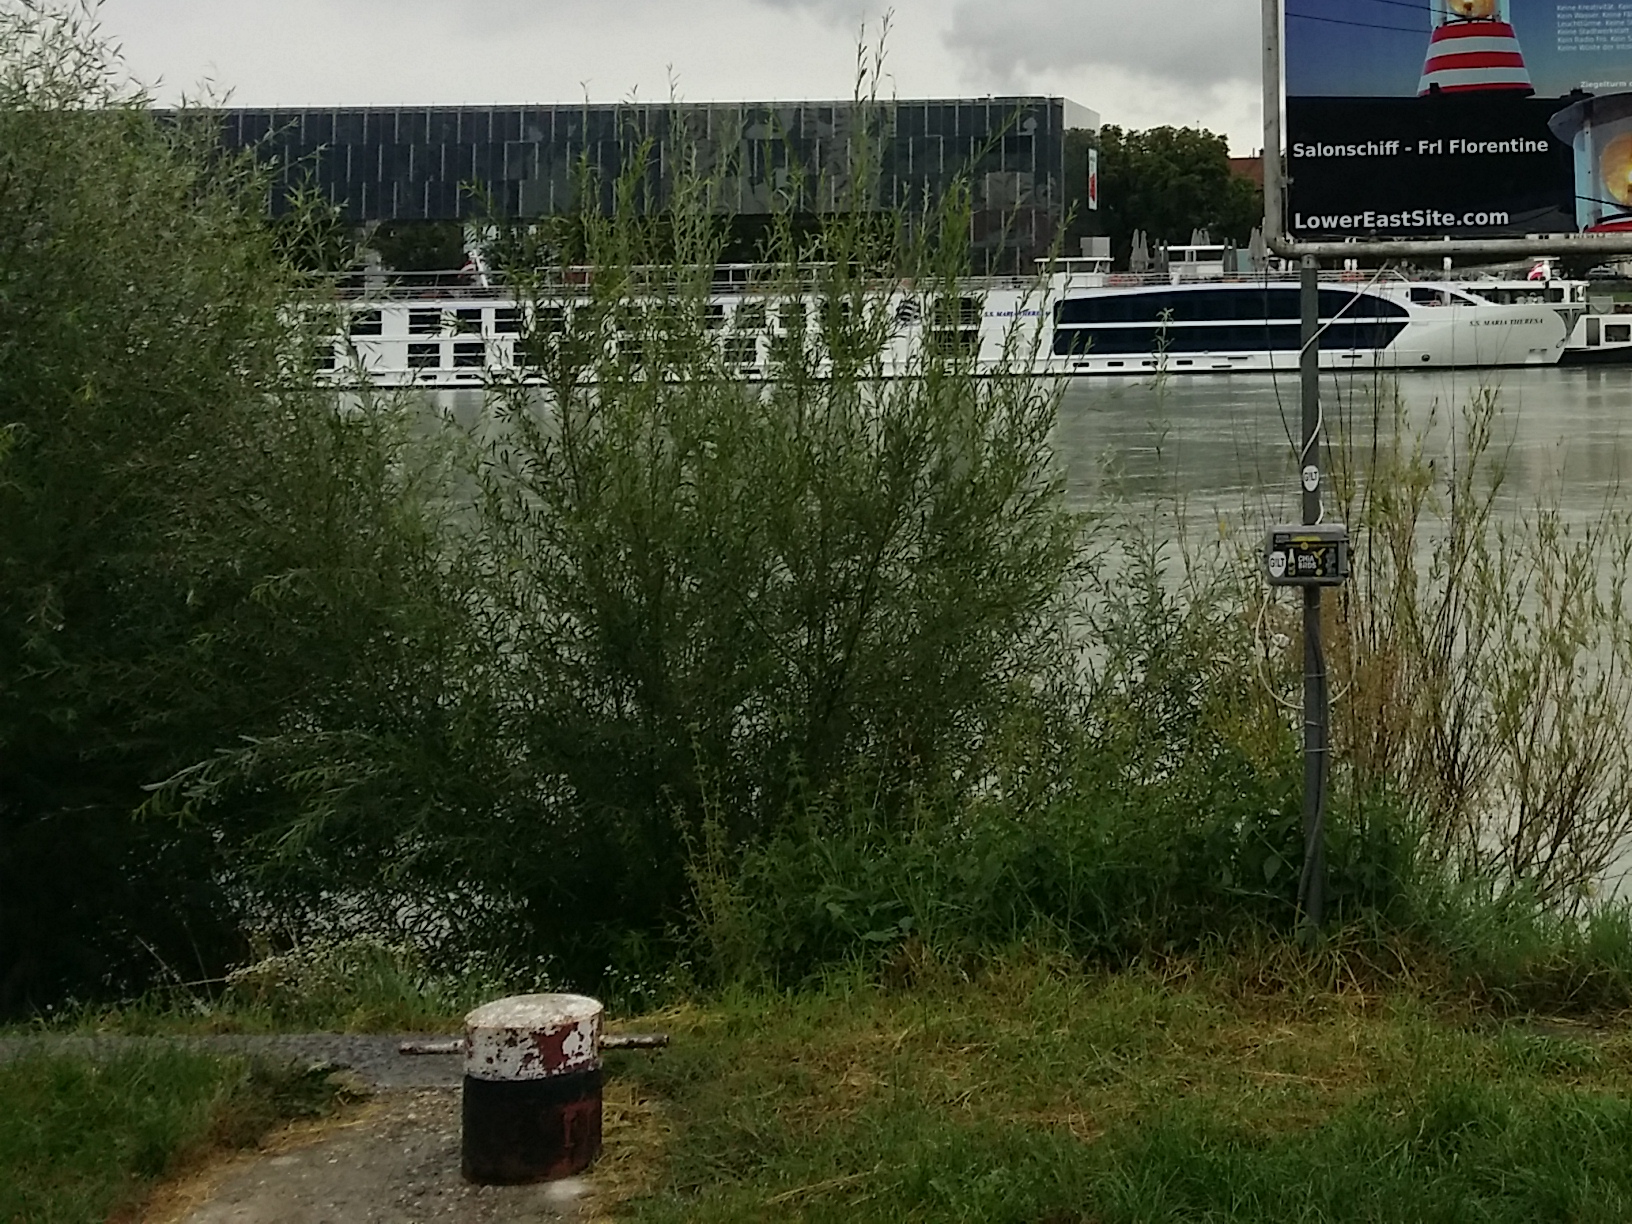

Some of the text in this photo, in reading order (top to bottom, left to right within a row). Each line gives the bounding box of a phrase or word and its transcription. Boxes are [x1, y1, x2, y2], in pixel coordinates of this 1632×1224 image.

[1580, 80, 1627, 88] Ziegelturm
[1292, 140, 1400, 157] Salonschiff
[1418, 139, 1443, 154] Frl
[1449, 137, 1549, 153] Florentine
[1294, 209, 1509, 229] LowerEastSite.com
